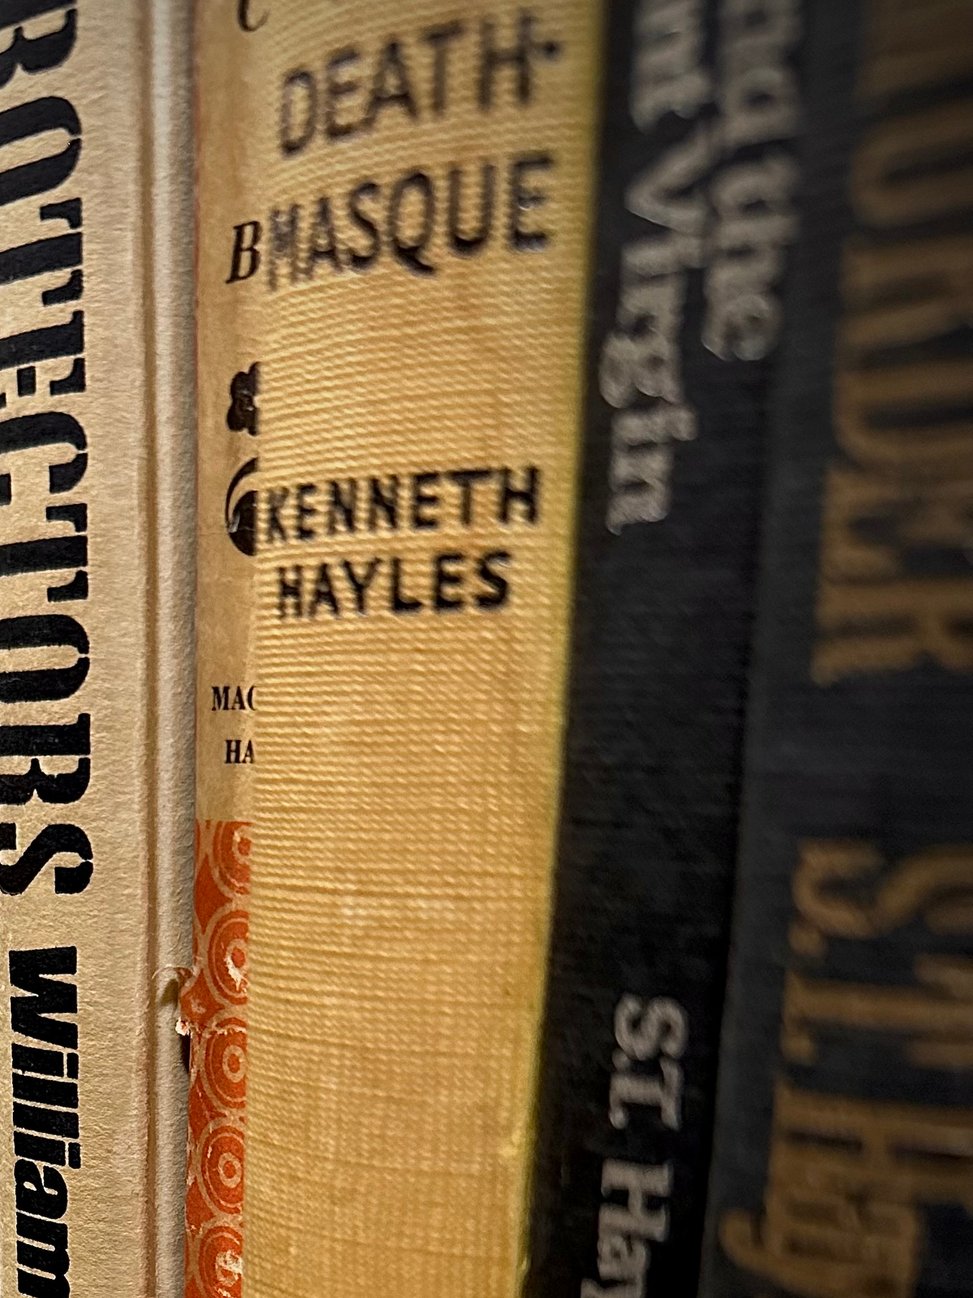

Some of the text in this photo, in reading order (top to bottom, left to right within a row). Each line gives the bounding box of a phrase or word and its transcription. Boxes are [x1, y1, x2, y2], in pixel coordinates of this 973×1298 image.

[267, 150, 555, 290] MASQUE
[599, 118, 739, 535] Virgin
[265, 465, 541, 545] KENNETH
[277, 550, 512, 621] HAYLES
